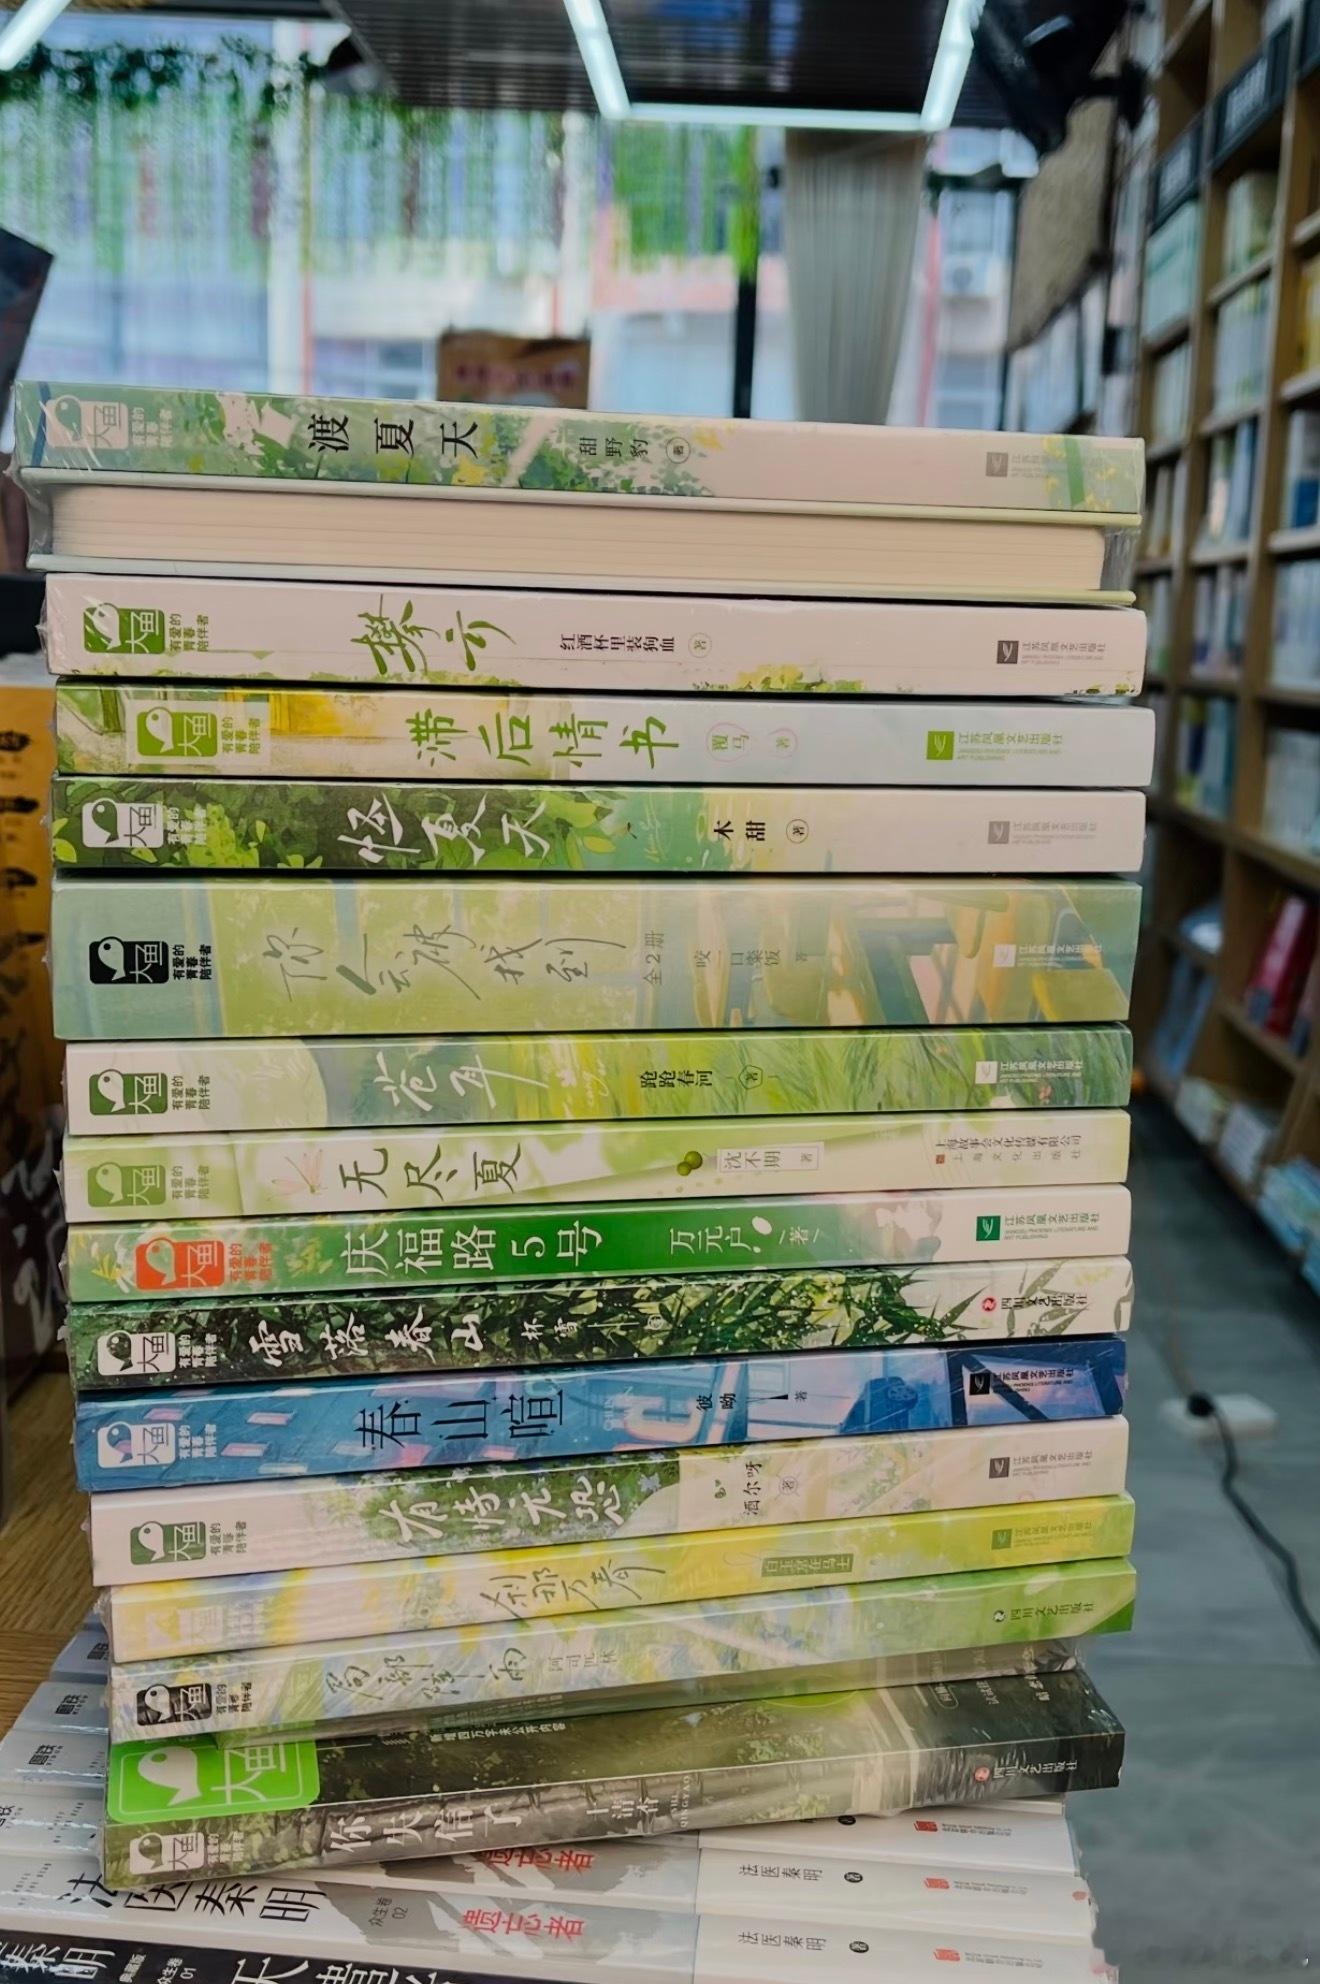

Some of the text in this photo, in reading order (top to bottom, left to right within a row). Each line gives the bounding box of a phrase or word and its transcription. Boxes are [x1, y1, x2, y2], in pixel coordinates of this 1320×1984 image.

[88, 405, 123, 448] 大鱼
[308, 413, 478, 459] 渡夏天
[579, 436, 649, 458] 甜野豹
[125, 610, 163, 654] 大鱼
[170, 613, 182, 652] 有爱的
[184, 627, 196, 652] 青春
[198, 614, 210, 652] 陪伴者
[352, 594, 517, 675] 攀云
[560, 633, 676, 654] 红酒杯里装狗血
[1021, 640, 1106, 653] 江苏凤凰文艺出版社
[178, 711, 213, 758] 大鱼
[222, 716, 234, 754] 有爱的
[236, 729, 248, 754] 青春
[249, 717, 261, 755] 陪伴者
[406, 706, 680, 770] 滞后情书
[957, 731, 1063, 746] 江苏凤凰文艺出版社
[124, 804, 159, 848] 大鱼
[338, 792, 550, 865] 怪夏天
[712, 820, 767, 842] 木甜
[792, 825, 806, 838] 著
[129, 943, 164, 984] 大鱼
[173, 944, 185, 980] 有爱的
[186, 956, 198, 980] 青春
[200, 944, 212, 981] 陪伴者
[266, 924, 628, 1001] 你会被找到
[643, 930, 666, 987] 全2册
[128, 1074, 165, 1115] 大鱼
[171, 1075, 184, 1112] 有爱的
[199, 1075, 211, 1112] 陪伴者
[374, 1050, 549, 1112] 苍耳
[639, 1069, 713, 1089] 跄跄春河
[186, 1086, 198, 1112] 青春
[340, 1143, 521, 1200] 无尽夏
[722, 1150, 781, 1170] 沈不期
[127, 1165, 162, 1206] 大鱼
[171, 1164, 183, 1201] 有爱的
[184, 1175, 197, 1201] 青春
[197, 1164, 210, 1200] 陪伴者
[790, 1228, 811, 1245] 著
[1004, 1213, 1101, 1229] 江苏凤凰文艺出版社
[339, 1219, 602, 1277] 庆福路5号
[669, 1223, 762, 1256] 万元户
[187, 1241, 220, 1287] 大鱼
[229, 1243, 242, 1282] 有爱的
[1000, 1291, 1088, 1311] 四川文艺出版社
[249, 1306, 484, 1367] 雪落春山
[520, 1318, 578, 1342] 杯雪
[137, 1332, 170, 1373] 大鱼
[179, 1334, 191, 1368] 有爱的
[696, 1391, 737, 1411] 彼呦
[795, 1391, 808, 1405] 著
[137, 1426, 170, 1465] 大鱼
[1012, 1449, 1093, 1465] 江苏凤凰文艺出版社
[379, 1477, 624, 1541] 有恃无恐
[173, 1521, 206, 1561] 大鱼
[210, 1521, 221, 1556] 有爱的
[223, 1530, 234, 1556] 青春
[235, 1520, 247, 1554] 陪伴者
[1010, 1601, 1094, 1621] 四川文艺出版社
[325, 1648, 528, 1700] 局部阵雨
[55, 1694, 80, 1715] 磨铁
[174, 1684, 209, 1722] 大鱼
[28, 1745, 57, 1766] 磨铁
[211, 1740, 286, 1806] 大鱼
[993, 1760, 1078, 1778] 四川文艺出版社
[680, 1776, 692, 1829] QINGYAO
[328, 1805, 523, 1853] 你失信了
[168, 1834, 200, 1870] 大鱼
[738, 1863, 824, 1882] 法医秦明
[57, 1870, 327, 1922] 法医秦明
[367, 1896, 392, 1929] 众生卷
[393, 1904, 408, 1921] 02
[463, 1907, 586, 1940] 遗忘者
[737, 1932, 827, 1951] 法医秦明
[180, 1966, 197, 1980] 01
